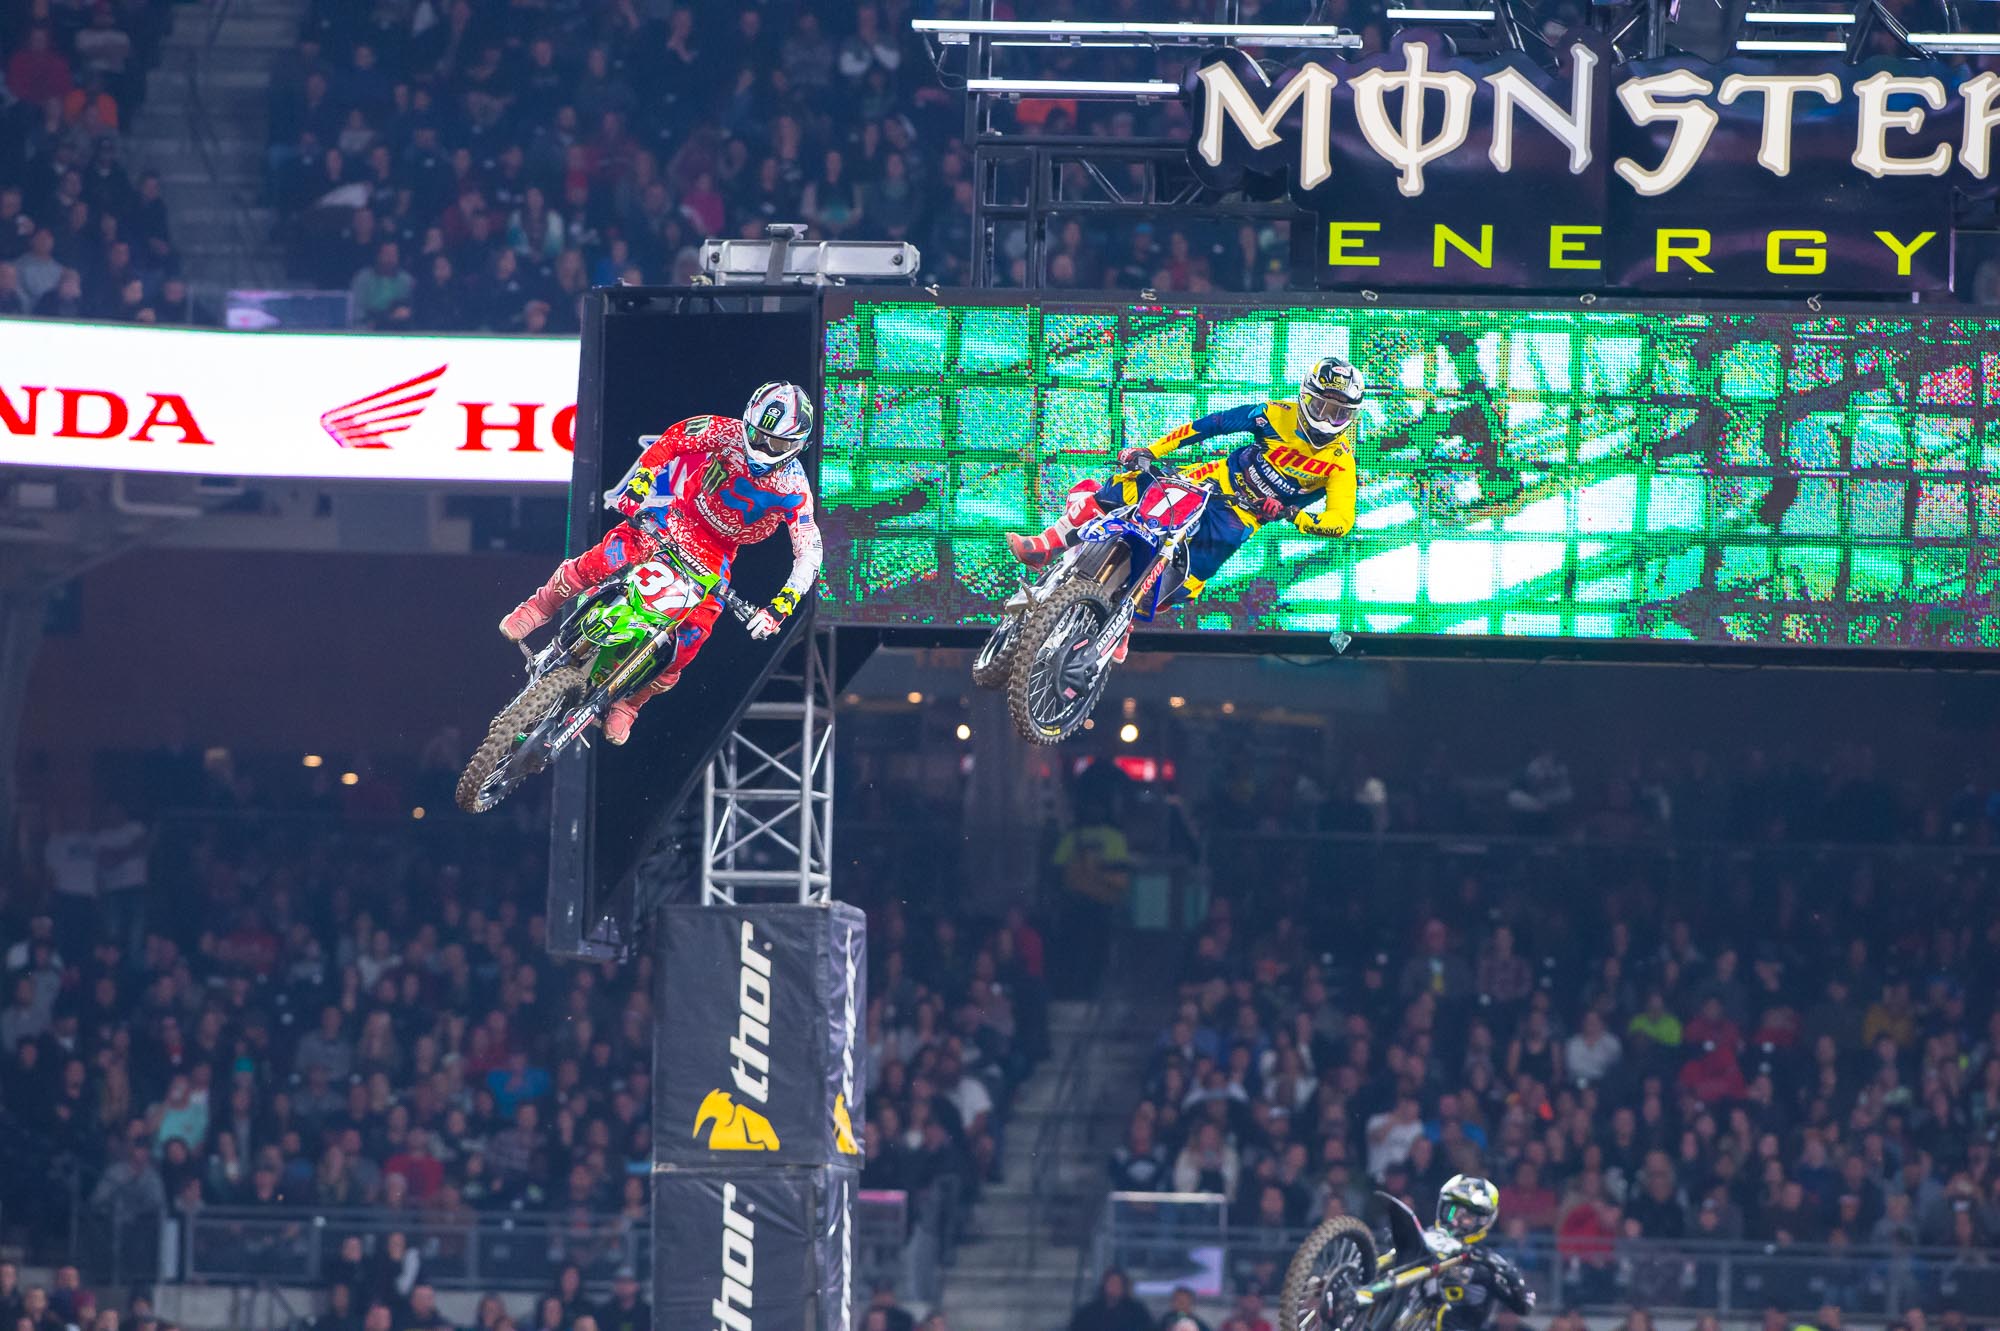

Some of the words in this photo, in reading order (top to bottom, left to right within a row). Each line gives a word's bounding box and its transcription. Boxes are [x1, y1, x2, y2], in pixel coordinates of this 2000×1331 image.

[1328, 222, 1937, 275] ENERGY
[697, 491, 742, 534] Kawasaki
[1147, 487, 1189, 518] 1
[627, 561, 702, 612] 37
[1095, 603, 1129, 652] DUNLOP
[555, 706, 592, 750] DUNLOP
[730, 919, 773, 1104] thor
[712, 1182, 755, 1331] hor
